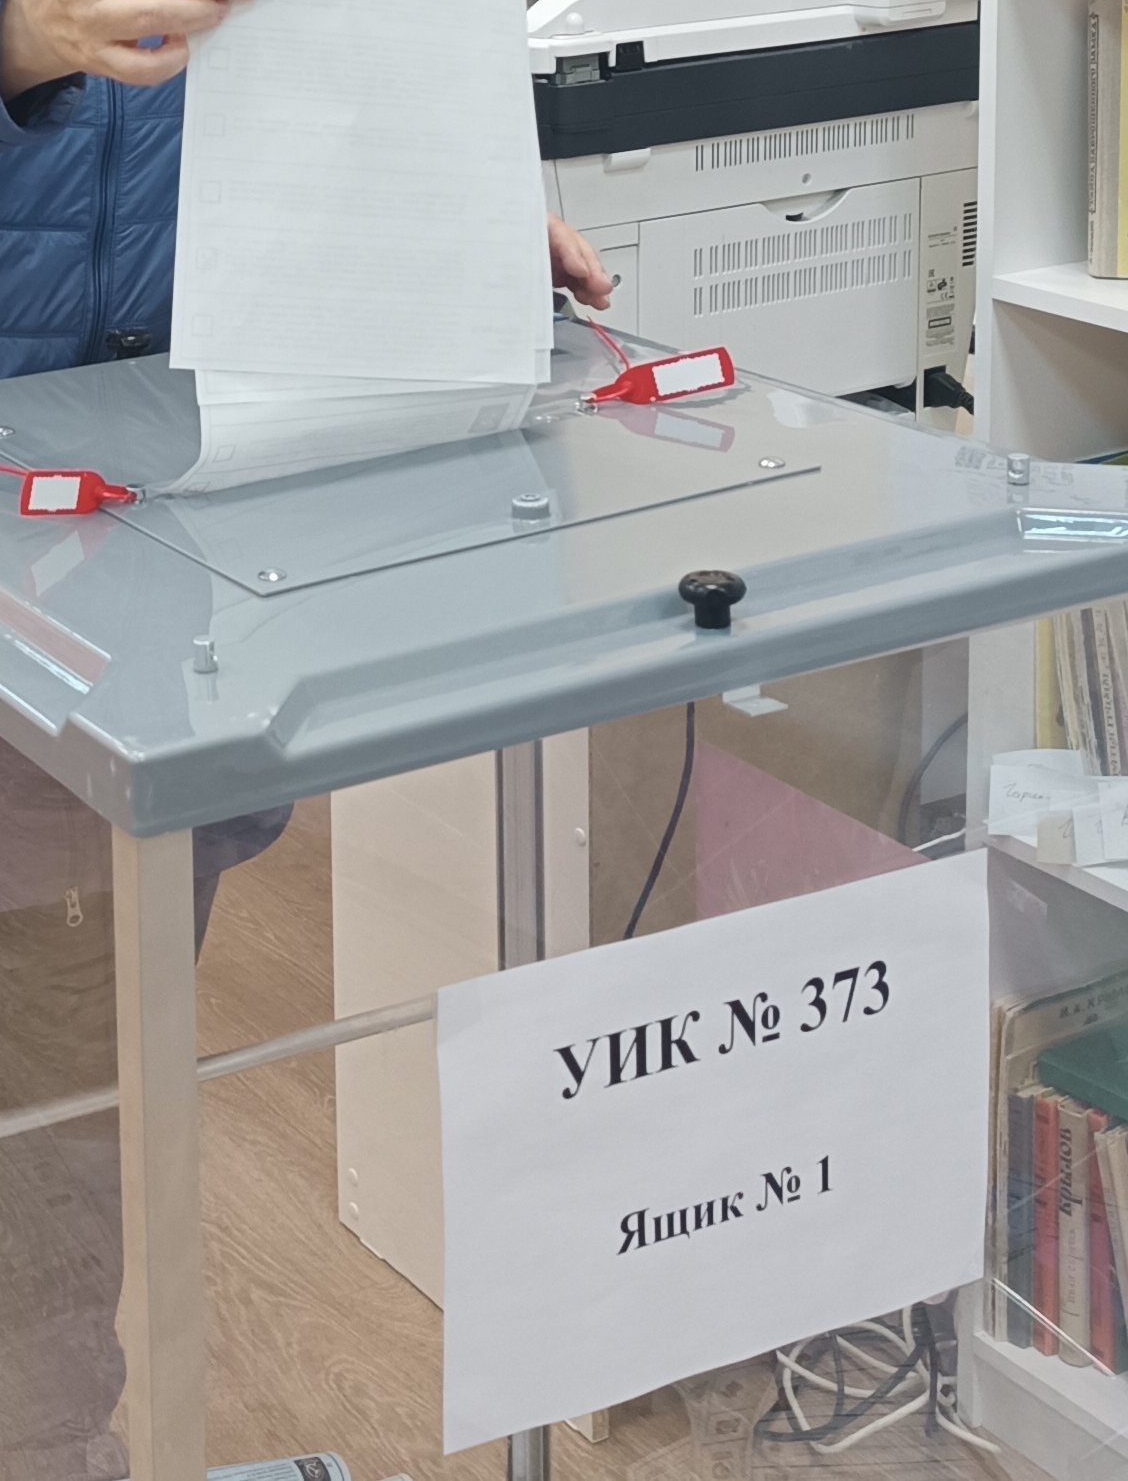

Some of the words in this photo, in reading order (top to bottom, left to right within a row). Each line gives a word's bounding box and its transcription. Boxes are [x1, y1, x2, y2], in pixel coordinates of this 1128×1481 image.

[553, 1010, 701, 1100] УИК
[718, 992, 781, 1055] №
[800, 960, 891, 1033] 373
[616, 1191, 744, 1256] Ящик
[756, 1166, 802, 1212] №
[816, 1155, 834, 1194] 1
